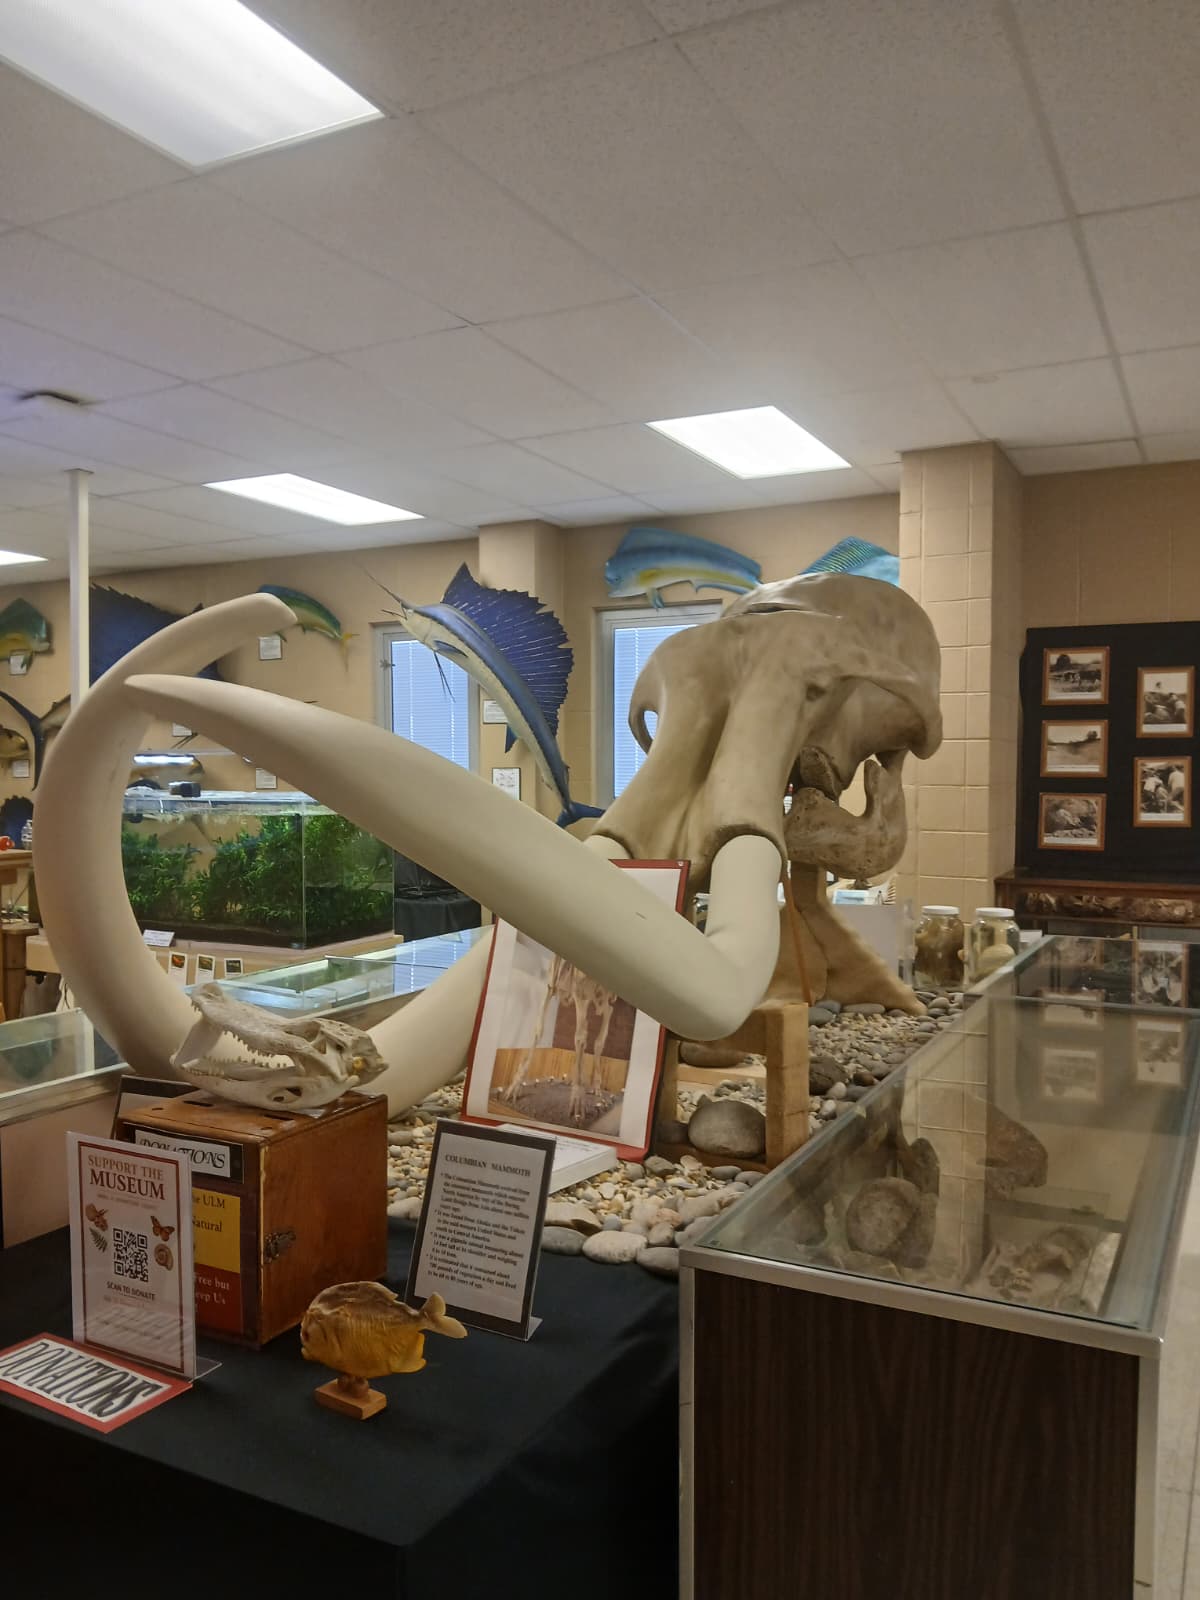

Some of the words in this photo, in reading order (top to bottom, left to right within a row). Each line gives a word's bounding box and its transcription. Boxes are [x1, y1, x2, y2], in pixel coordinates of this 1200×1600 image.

[140, 1138, 226, 1169] DONTIONS
[87, 1154, 138, 1176] SUPPORT
[141, 1164, 164, 1181] THE
[445, 1155, 487, 1168] COLUMBIAN
[491, 1163, 532, 1176] MAMMOTH
[88, 1169, 166, 1201] MUSEUM
[203, 1194, 225, 1209] ULM
[106, 1281, 122, 1293] SCAN
[122, 1286, 131, 1294] TO
[131, 1288, 156, 1301] DONATE
[215, 1276, 230, 1291] but
[213, 1292, 226, 1305] Us
[0, 1341, 162, 1417] DONATIONS
